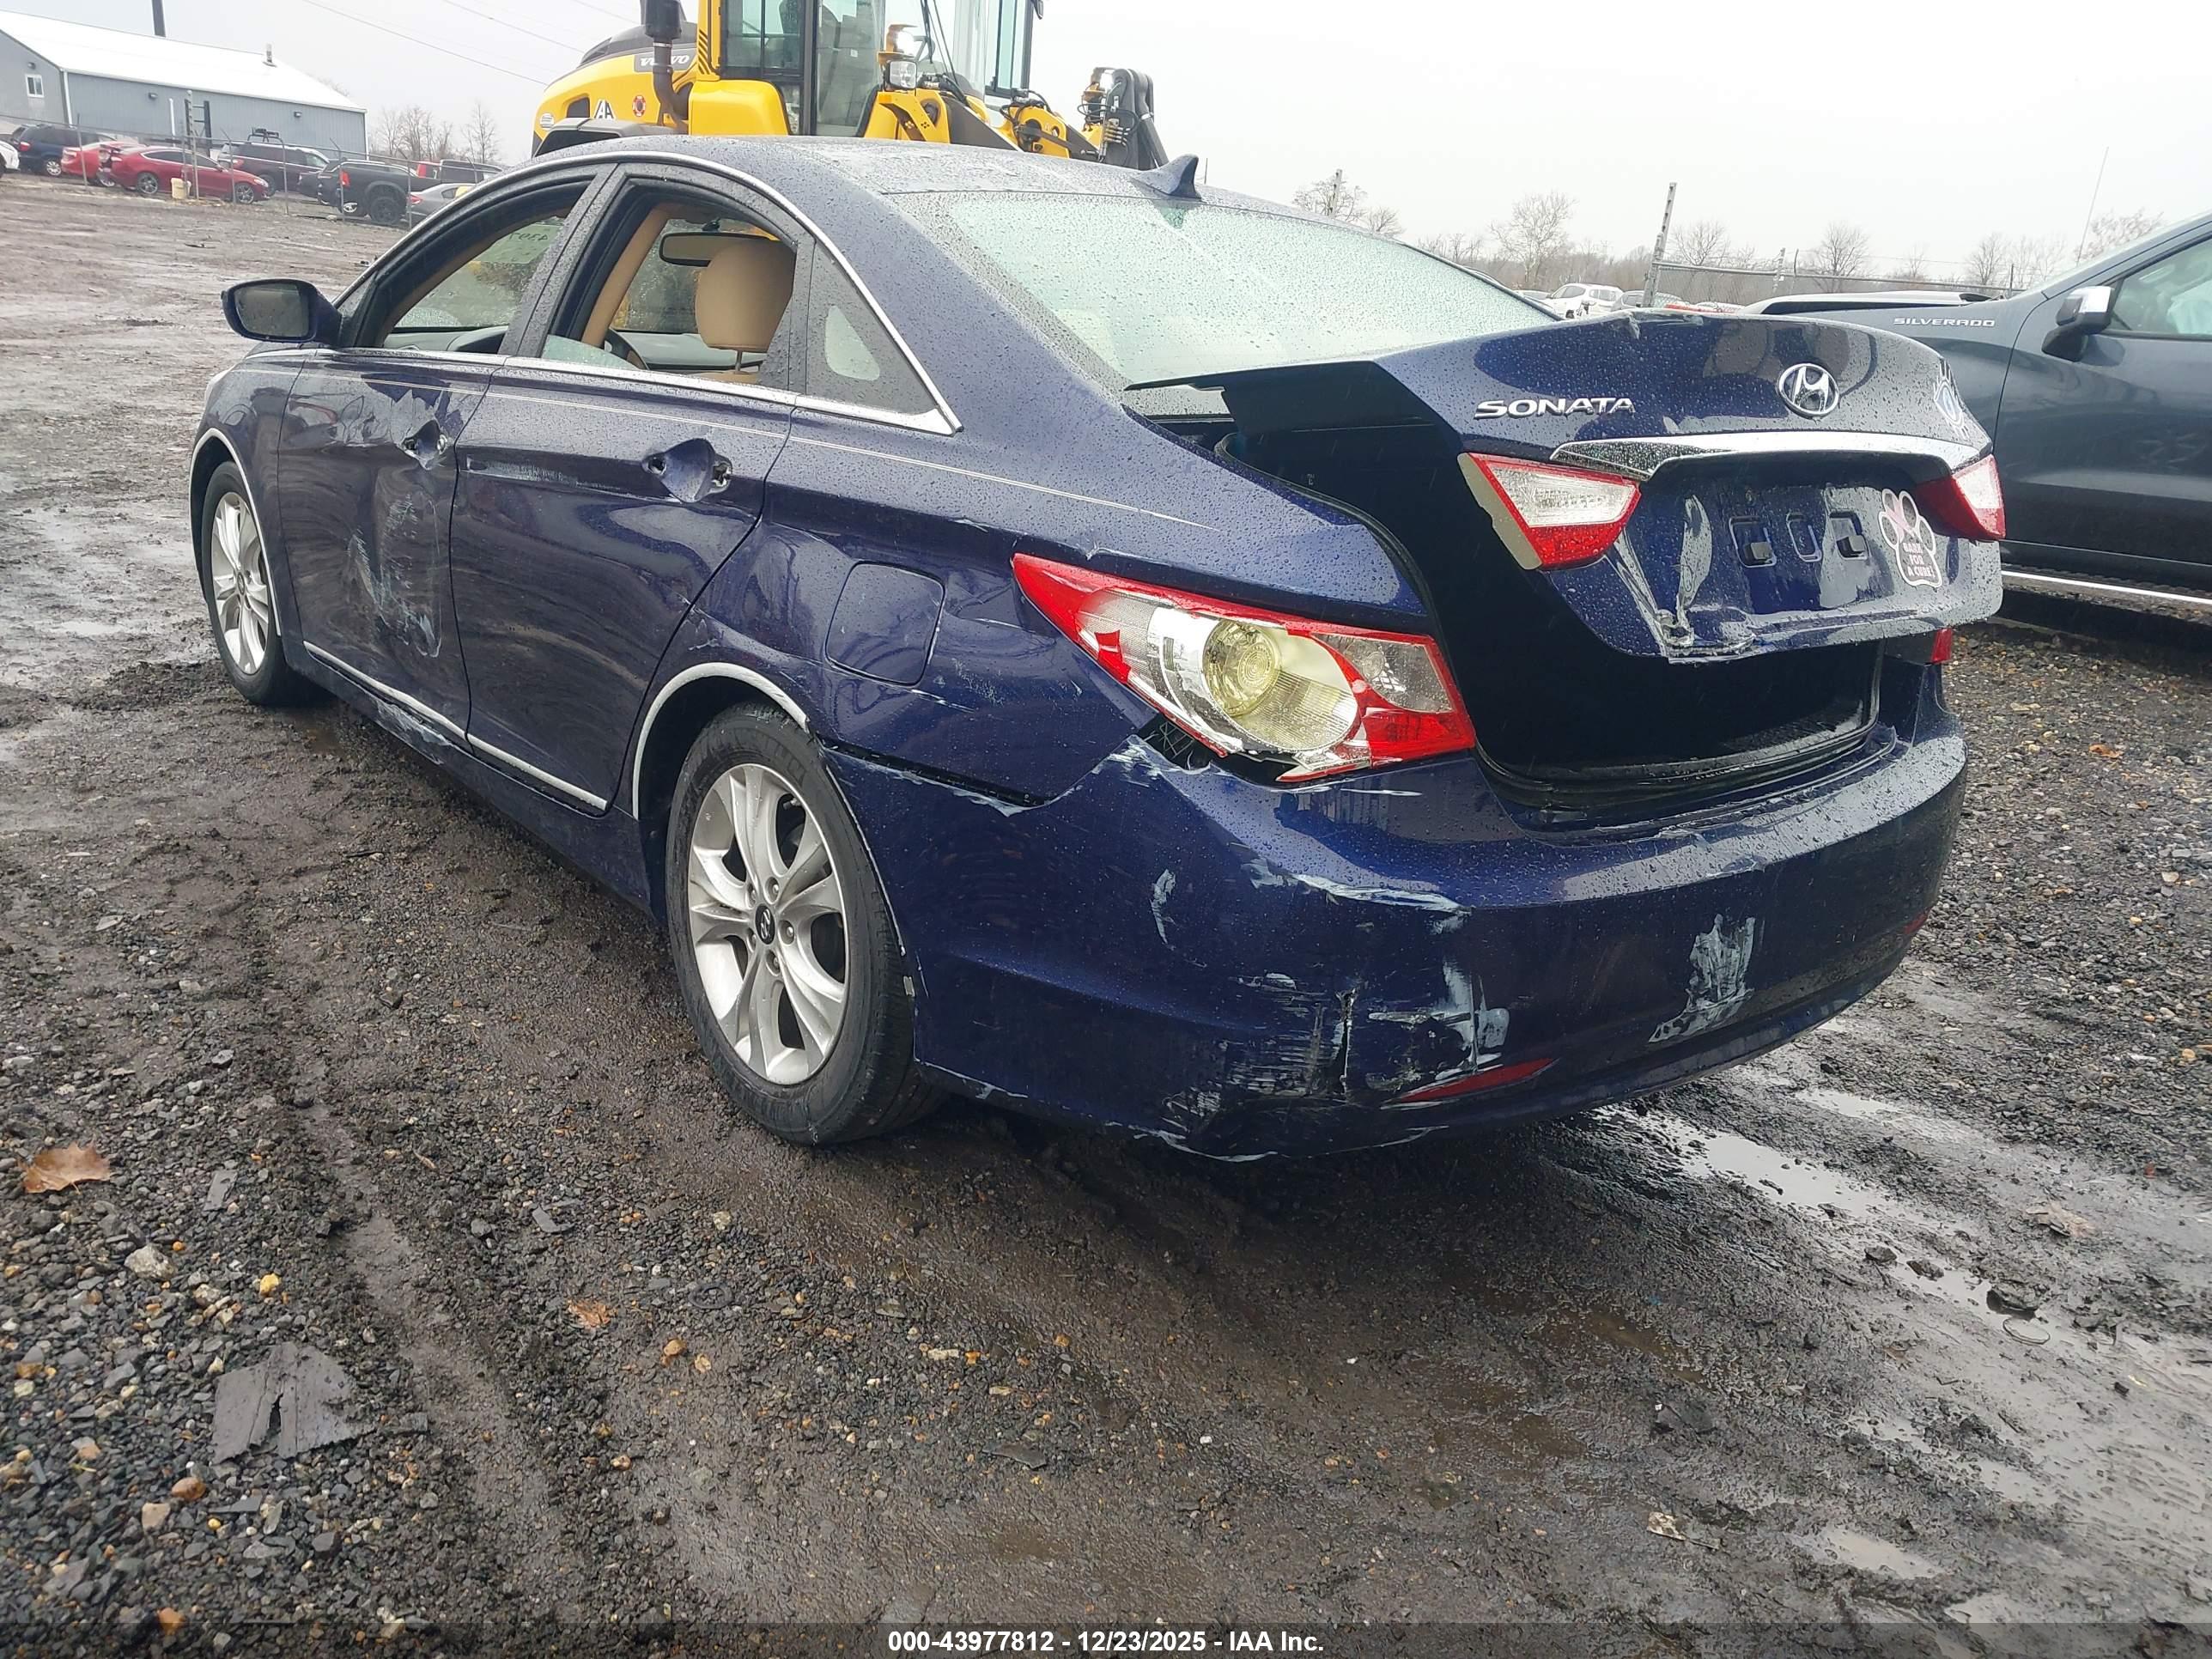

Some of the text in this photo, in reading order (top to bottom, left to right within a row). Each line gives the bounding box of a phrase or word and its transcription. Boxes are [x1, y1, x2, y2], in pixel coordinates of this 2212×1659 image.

[640, 55, 690, 66] VVO
[1893, 318, 1996, 327] SILVERADO
[1474, 398, 1637, 420] SONATA
[1908, 554, 1924, 565] FOR
